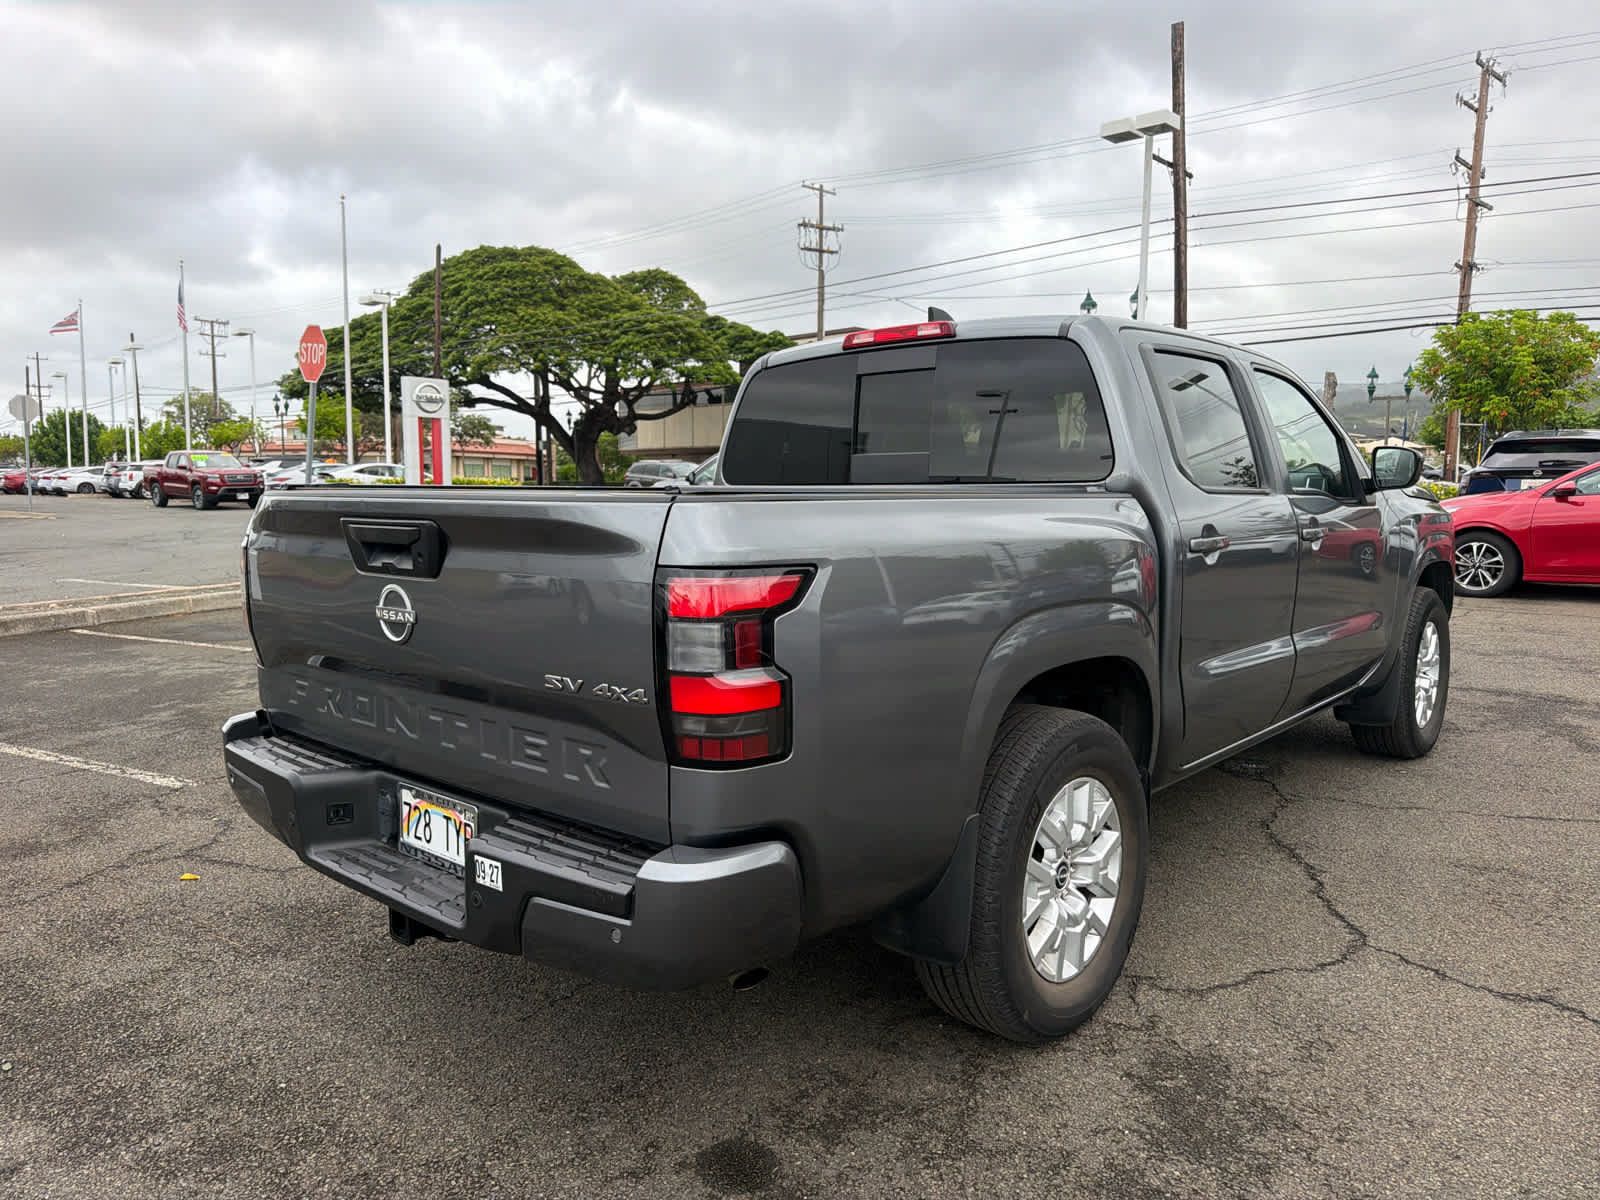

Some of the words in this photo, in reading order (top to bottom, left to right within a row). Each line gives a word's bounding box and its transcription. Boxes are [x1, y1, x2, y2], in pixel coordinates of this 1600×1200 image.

[300, 342, 326, 365] STOP
[375, 606, 416, 624] NISSAN
[544, 673, 584, 694] SV
[288, 678, 611, 790] FRONTIER
[403, 802, 432, 844] 728
[488, 863, 499, 884] 27
